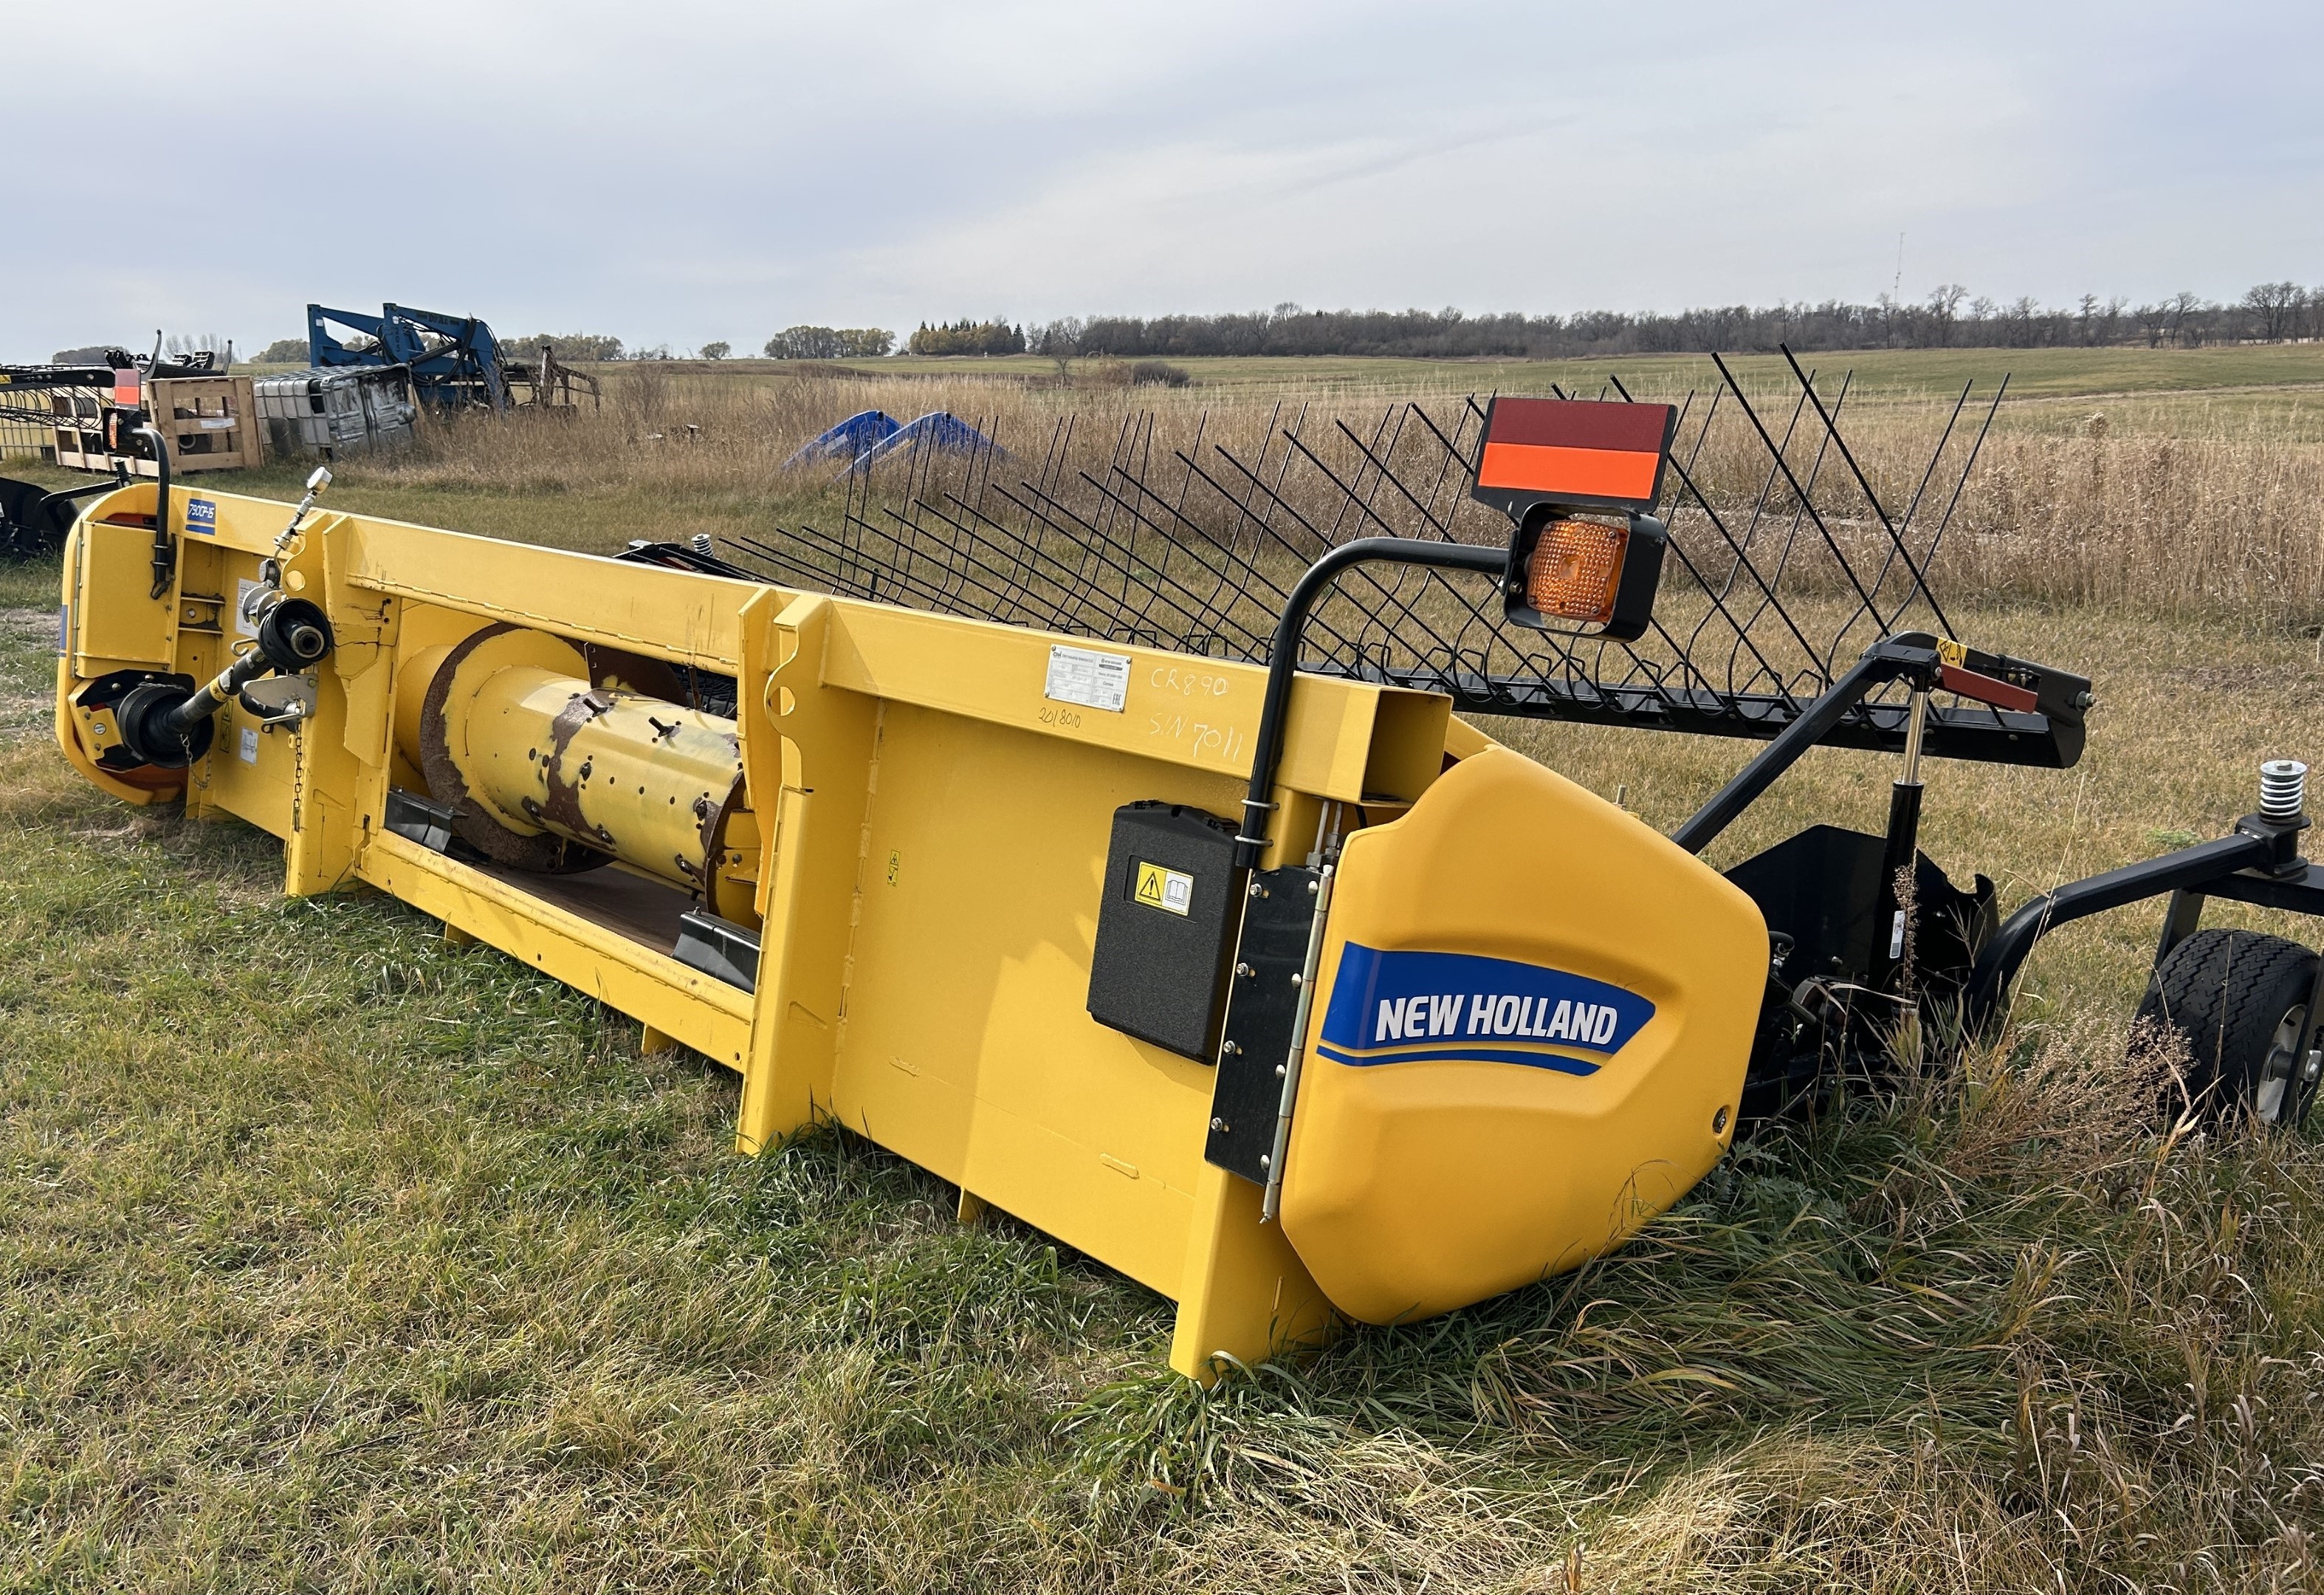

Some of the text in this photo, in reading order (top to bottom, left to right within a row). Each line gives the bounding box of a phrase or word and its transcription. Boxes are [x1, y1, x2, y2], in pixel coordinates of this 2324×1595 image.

[1193, 723, 1242, 762] 7011
[1375, 995, 1617, 1045] NEW HOLLAND
